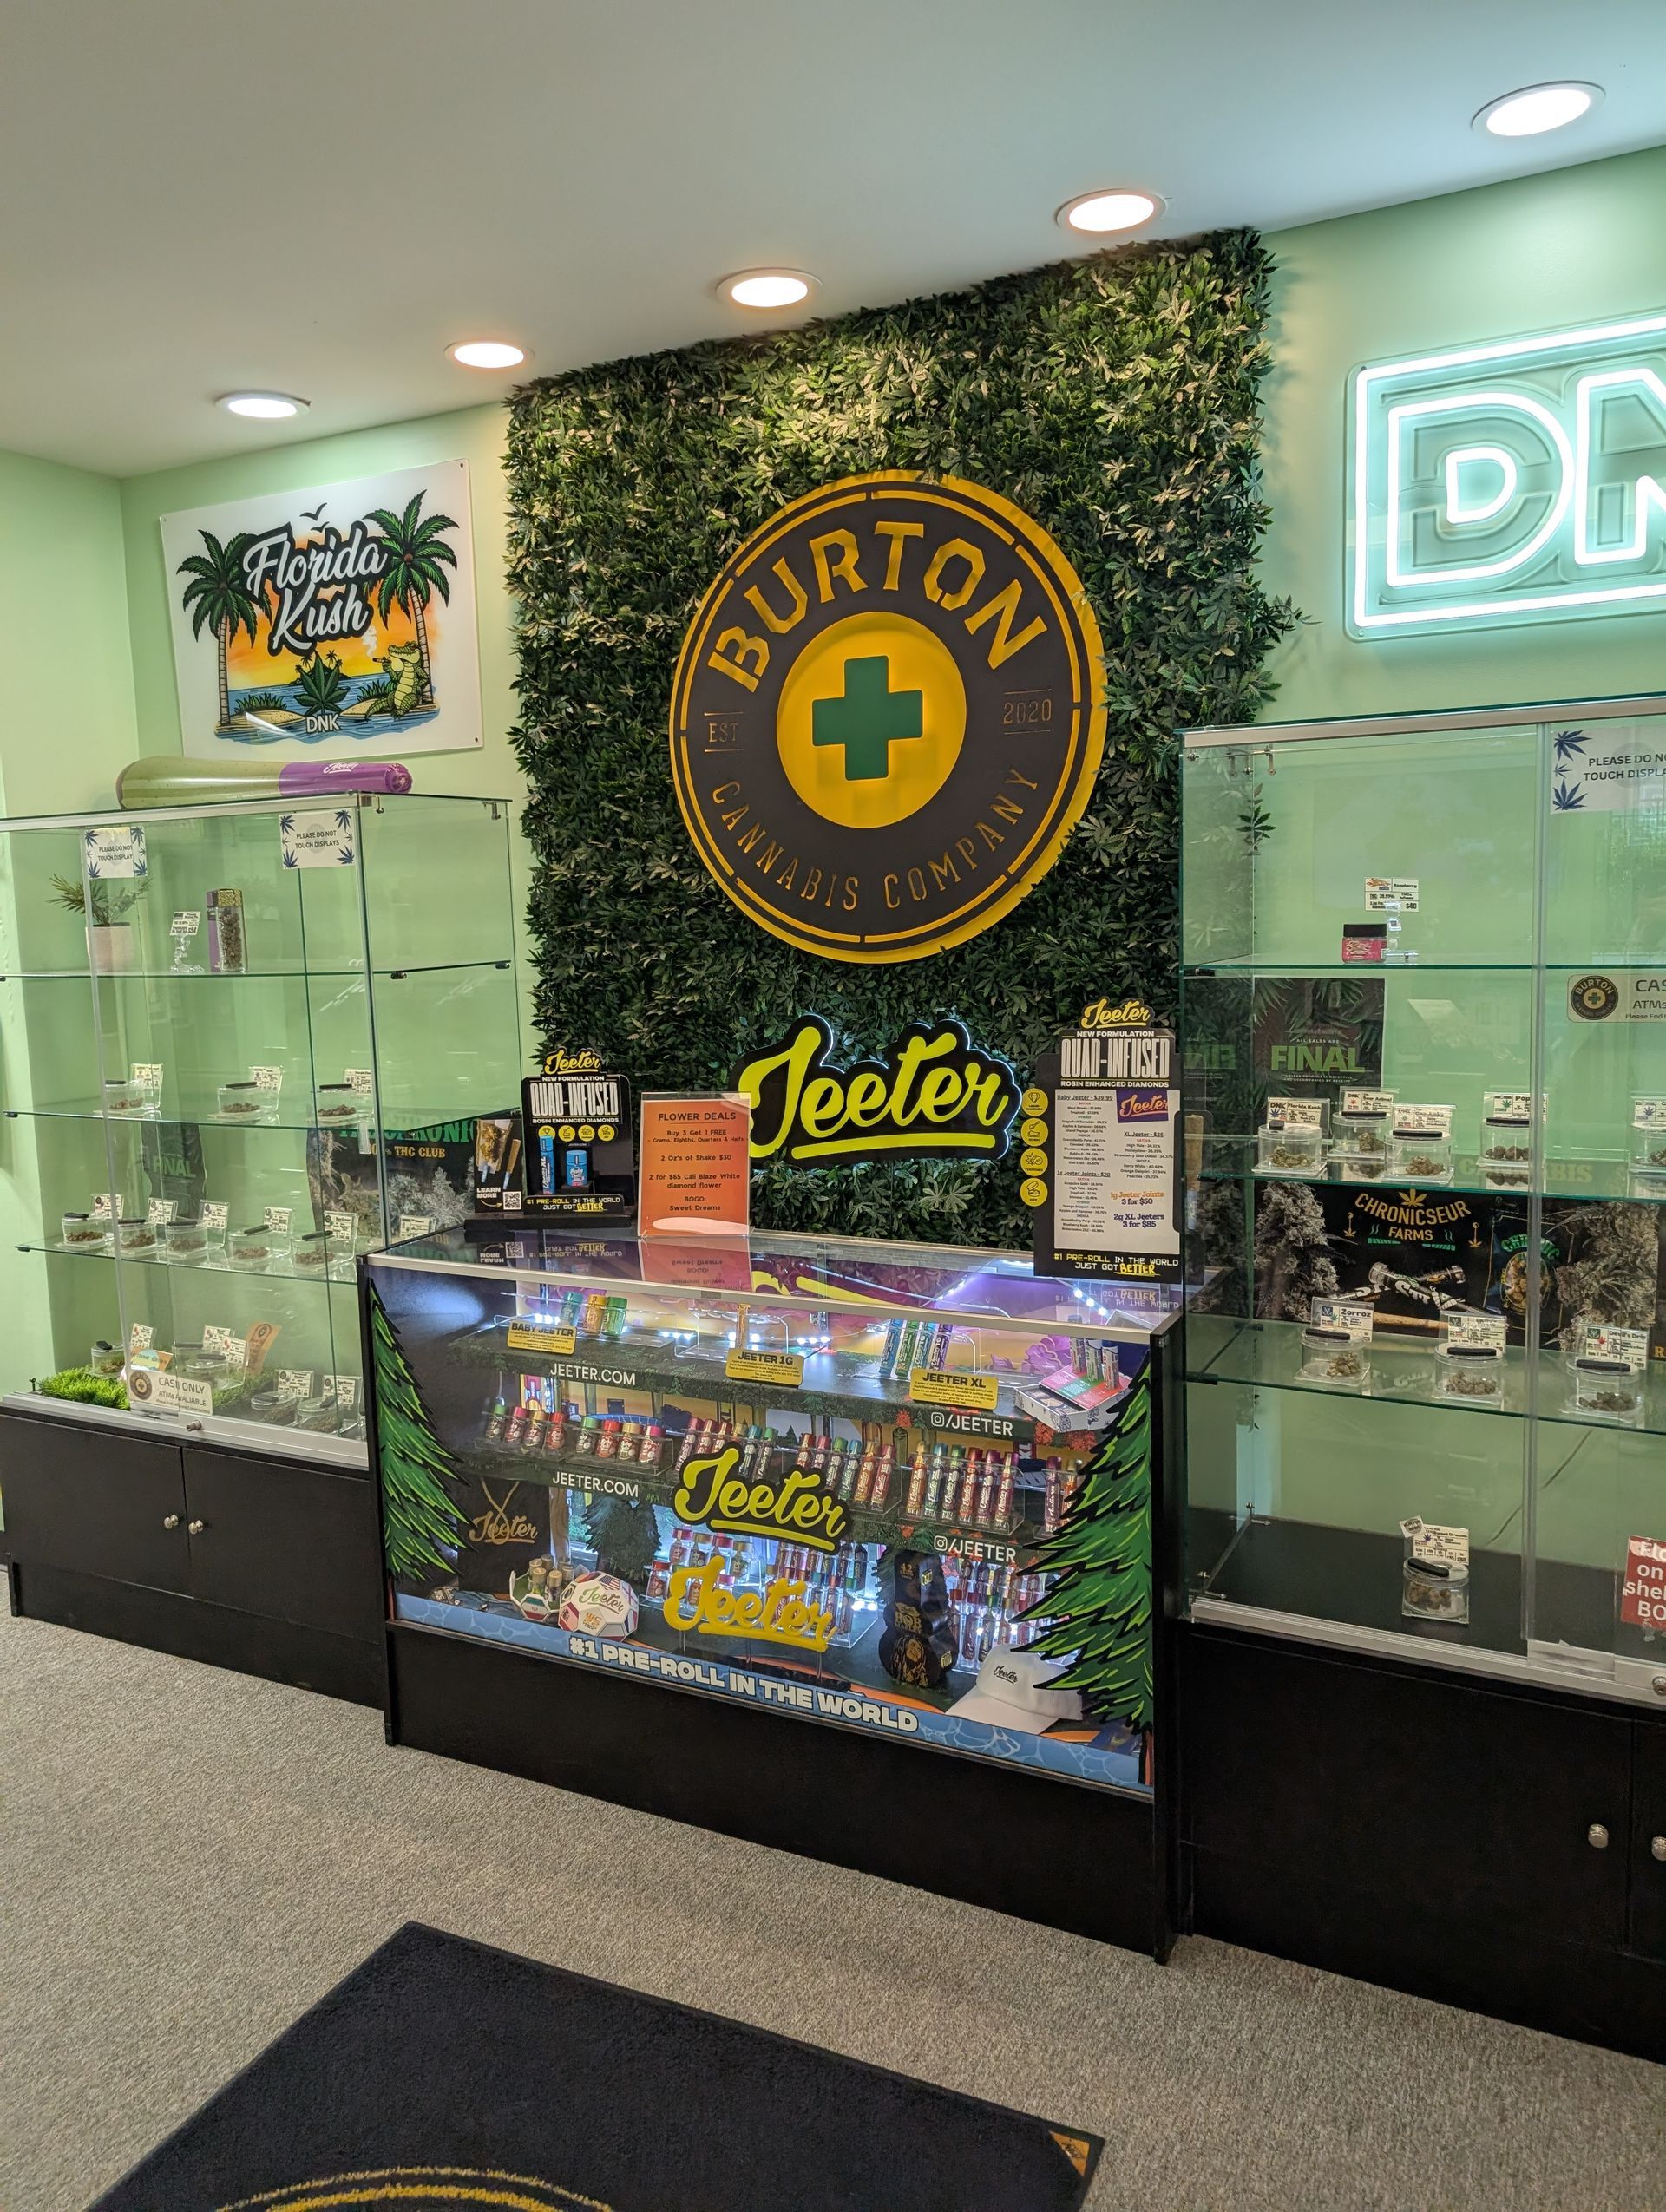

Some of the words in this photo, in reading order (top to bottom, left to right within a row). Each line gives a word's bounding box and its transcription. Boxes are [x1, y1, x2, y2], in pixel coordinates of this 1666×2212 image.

[243, 526, 389, 596] Florida
[708, 521, 1048, 692] BURTON
[272, 586, 371, 651] Kush
[305, 715, 340, 734] DNK
[709, 723, 738, 743] EST
[1003, 699, 1052, 724] 2020
[1589, 756, 1631, 766] PLEASE
[1634, 755, 1651, 763] DO
[1584, 771, 1624, 781] TOUCH
[295, 841, 314, 850] TOUCH
[314, 840, 340, 848] DISPLAYS
[297, 831, 316, 840] PLEASE
[317, 830, 325, 839] DO
[325, 829, 338, 838] NOT
[713, 781, 859, 912] CANNABIS
[883, 768, 1039, 909] COMPANY
[1575, 978, 1615, 995] BURTON
[1081, 998, 1151, 1029] Jeeter
[544, 1050, 602, 1075] Jeeter
[1060, 1038, 1171, 1078] QUAD-INFUSED
[1270, 1044, 1366, 1073] FINAL
[530, 1082, 619, 1116] QUAD-INFUSED
[738, 1026, 1008, 1159] Jeeter
[1119, 1094, 1169, 1117] Jeeter
[395, 1146, 416, 1156] THC
[419, 1147, 445, 1157] CLUB
[153, 1156, 196, 1178] FINAL
[576, 1203, 604, 1212] BETTER
[1139, 1197, 1153, 1206] $50
[1354, 1192, 1473, 1226] CHRONICSEUR
[1141, 1220, 1157, 1228] $85
[1388, 1226, 1433, 1240] FARMS
[1066, 1253, 1111, 1263] PRE-ROLL
[1150, 1258, 1179, 1266] WORLD
[1119, 1263, 1156, 1275] BETTER
[1341, 1308, 1372, 1318] Zorroz
[511, 1322, 536, 1332] BABY
[538, 1325, 574, 1337] JEETER
[738, 1351, 777, 1364] JEETER
[778, 1356, 793, 1365] 1G
[550, 1363, 636, 1386] JEETER.COM
[922, 1372, 969, 1385] JEETER
[970, 1378, 986, 1388] XL
[181, 1382, 205, 1394] ONLY
[946, 1414, 1013, 1436] /JEETER
[552, 1471, 639, 1498] JEETER.COM
[674, 1447, 846, 1551] Jeeter
[469, 1510, 538, 1544] Jeeter
[949, 1538, 1016, 1562] /JEETER
[1637, 1564, 1663, 1580] on
[579, 1586, 625, 1614] Jeeter
[663, 1555, 836, 1652] Jeeter
[569, 1635, 599, 1659] #1
[601, 1644, 725, 1685] PRE-ROLL
[728, 1672, 755, 1695] IN
[759, 1684, 814, 1710] THE
[817, 1695, 920, 1733] WORLD
[993, 1666, 1019, 1685] Jeeter
